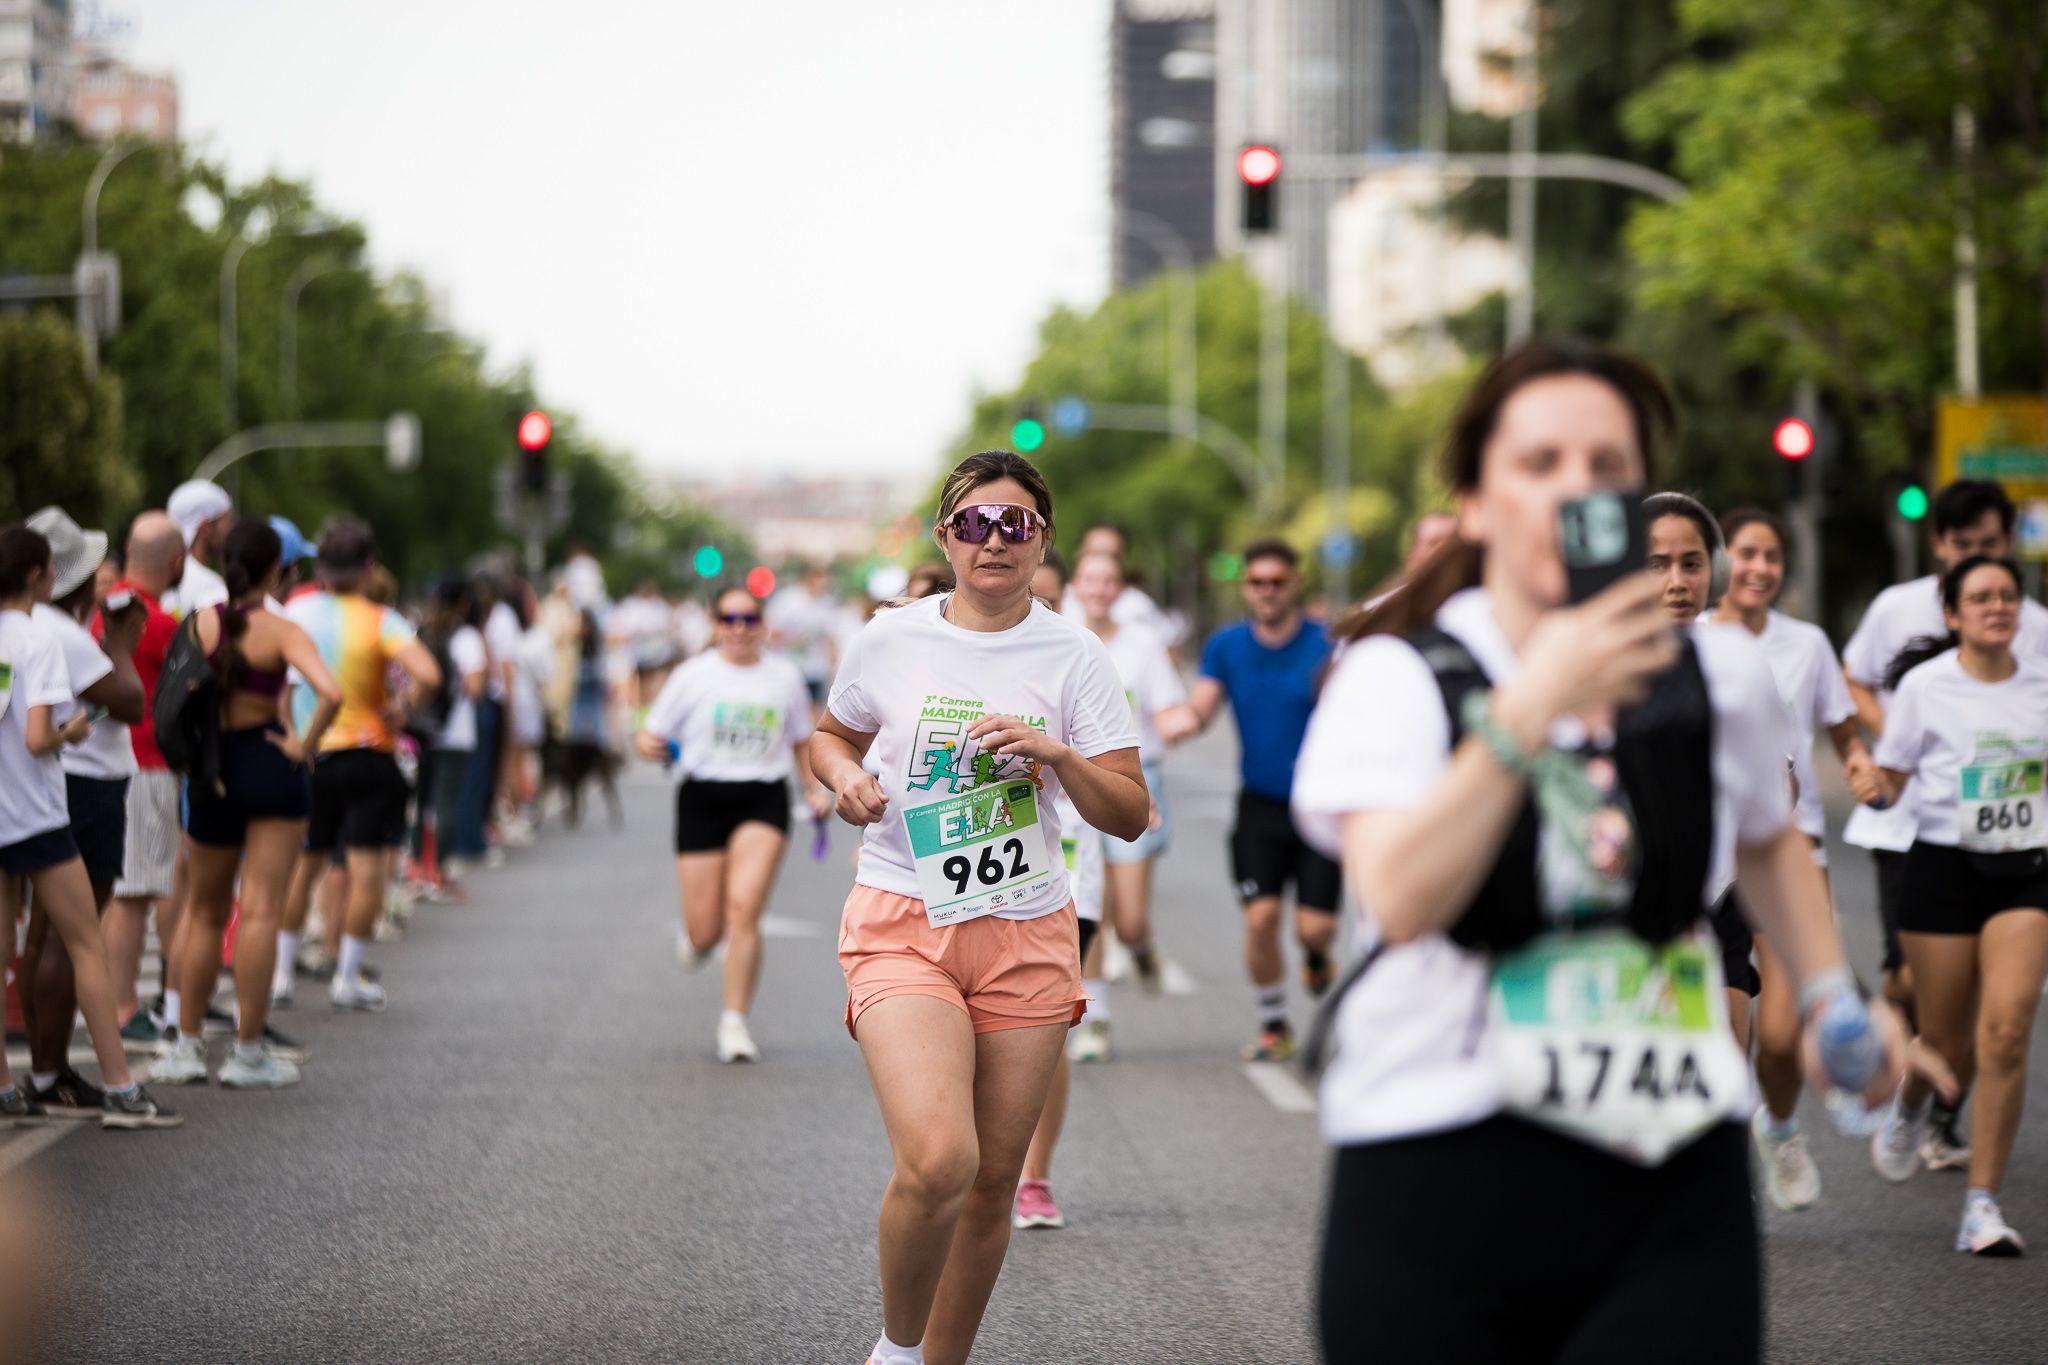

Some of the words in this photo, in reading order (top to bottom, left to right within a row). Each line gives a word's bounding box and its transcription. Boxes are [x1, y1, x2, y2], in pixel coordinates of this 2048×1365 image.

[939, 696, 984, 709] Carrera
[1028, 715, 1047, 728] LA
[916, 808, 937, 817] Carrera
[938, 799, 972, 813] MADRID
[972, 793, 990, 804] CON
[991, 789, 1002, 797] LA
[1976, 800, 2033, 835] 860
[942, 837, 1031, 896] 962
[1540, 1042, 1712, 1106] 1744
